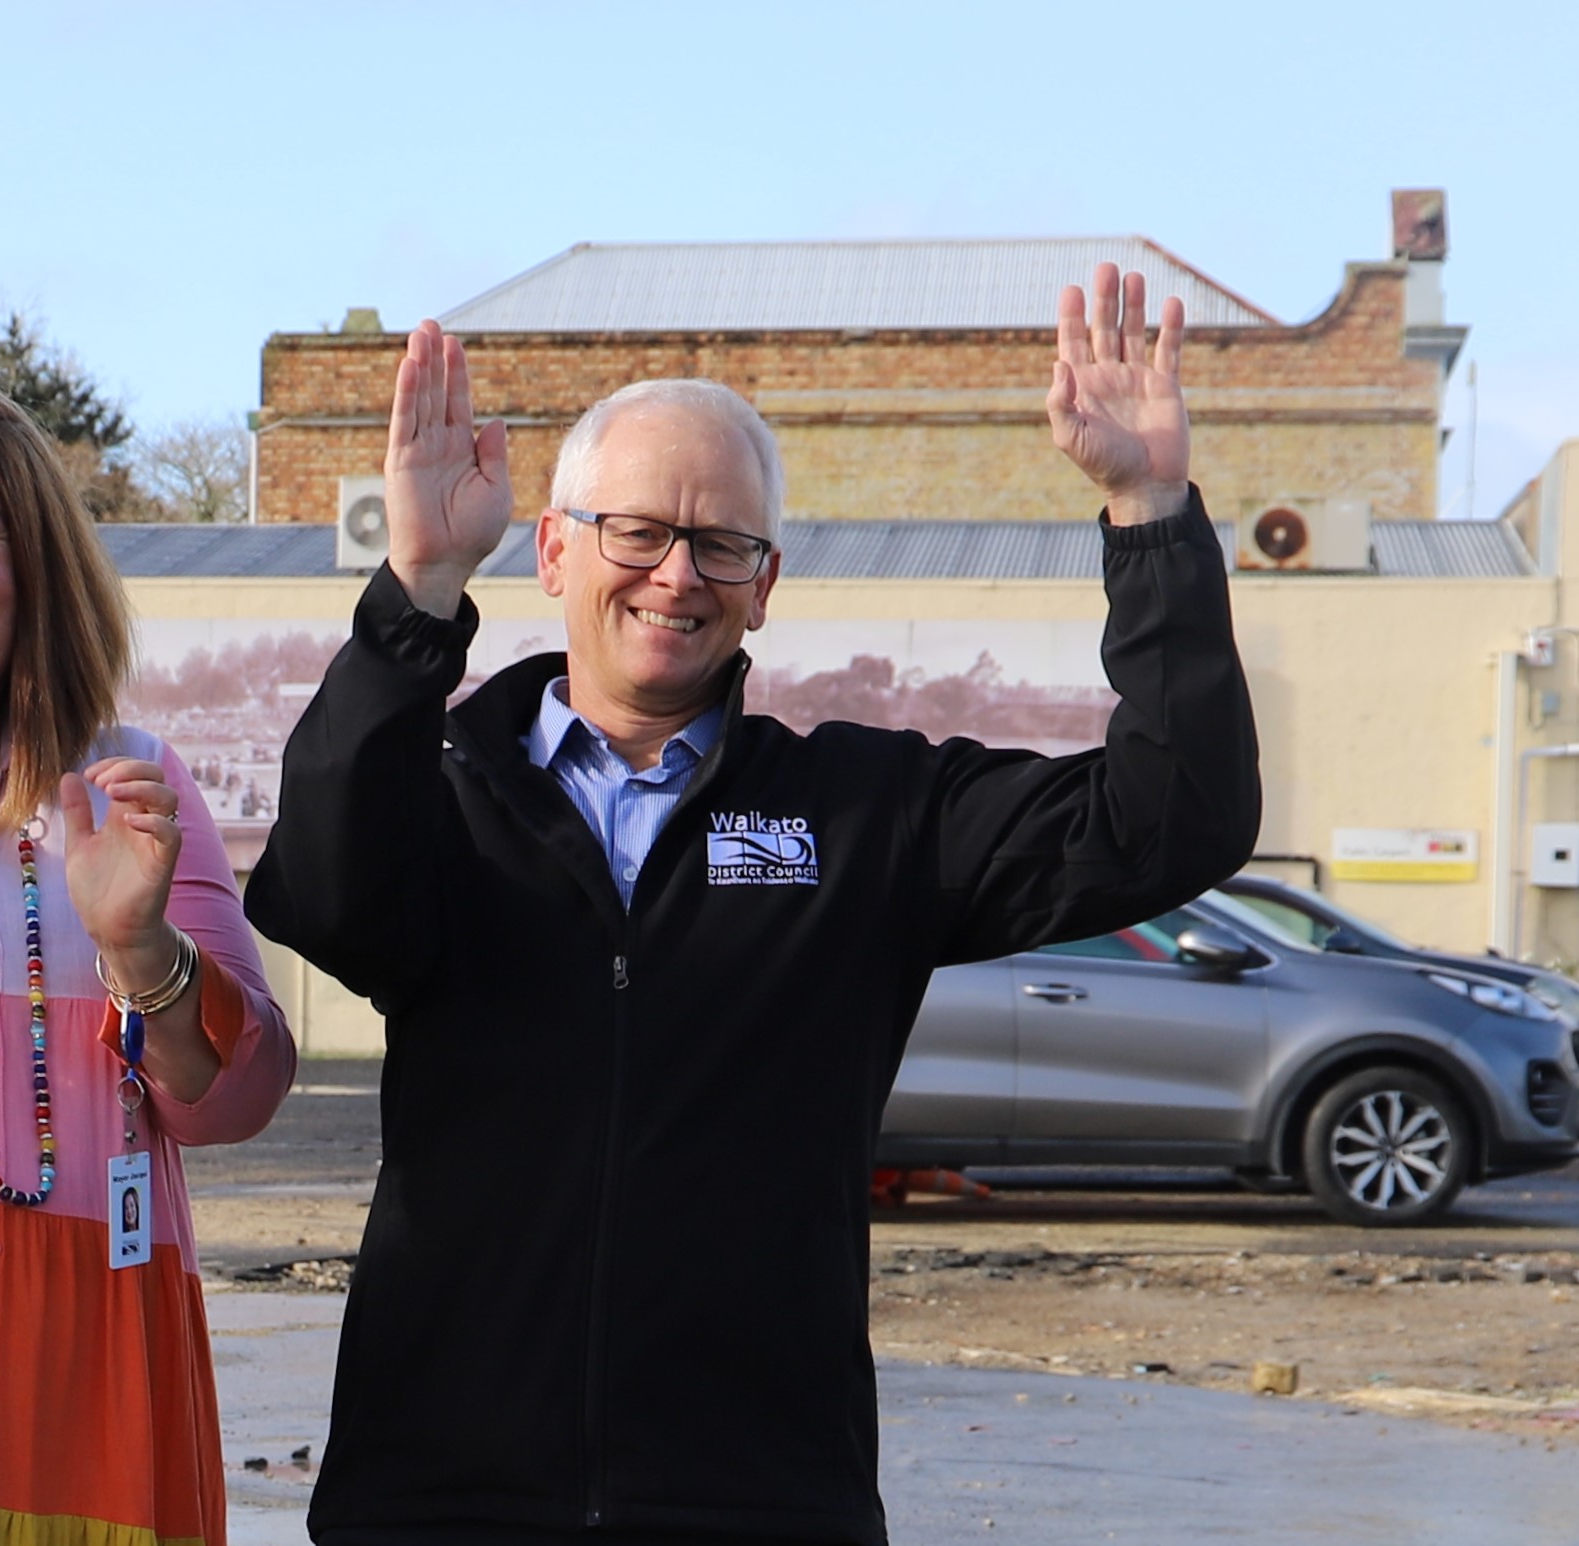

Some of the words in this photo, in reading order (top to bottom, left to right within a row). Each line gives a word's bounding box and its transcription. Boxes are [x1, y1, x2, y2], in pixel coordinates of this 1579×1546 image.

[710, 810, 808, 833] Waikato
[708, 865, 763, 878] District
[766, 865, 818, 878] Council
